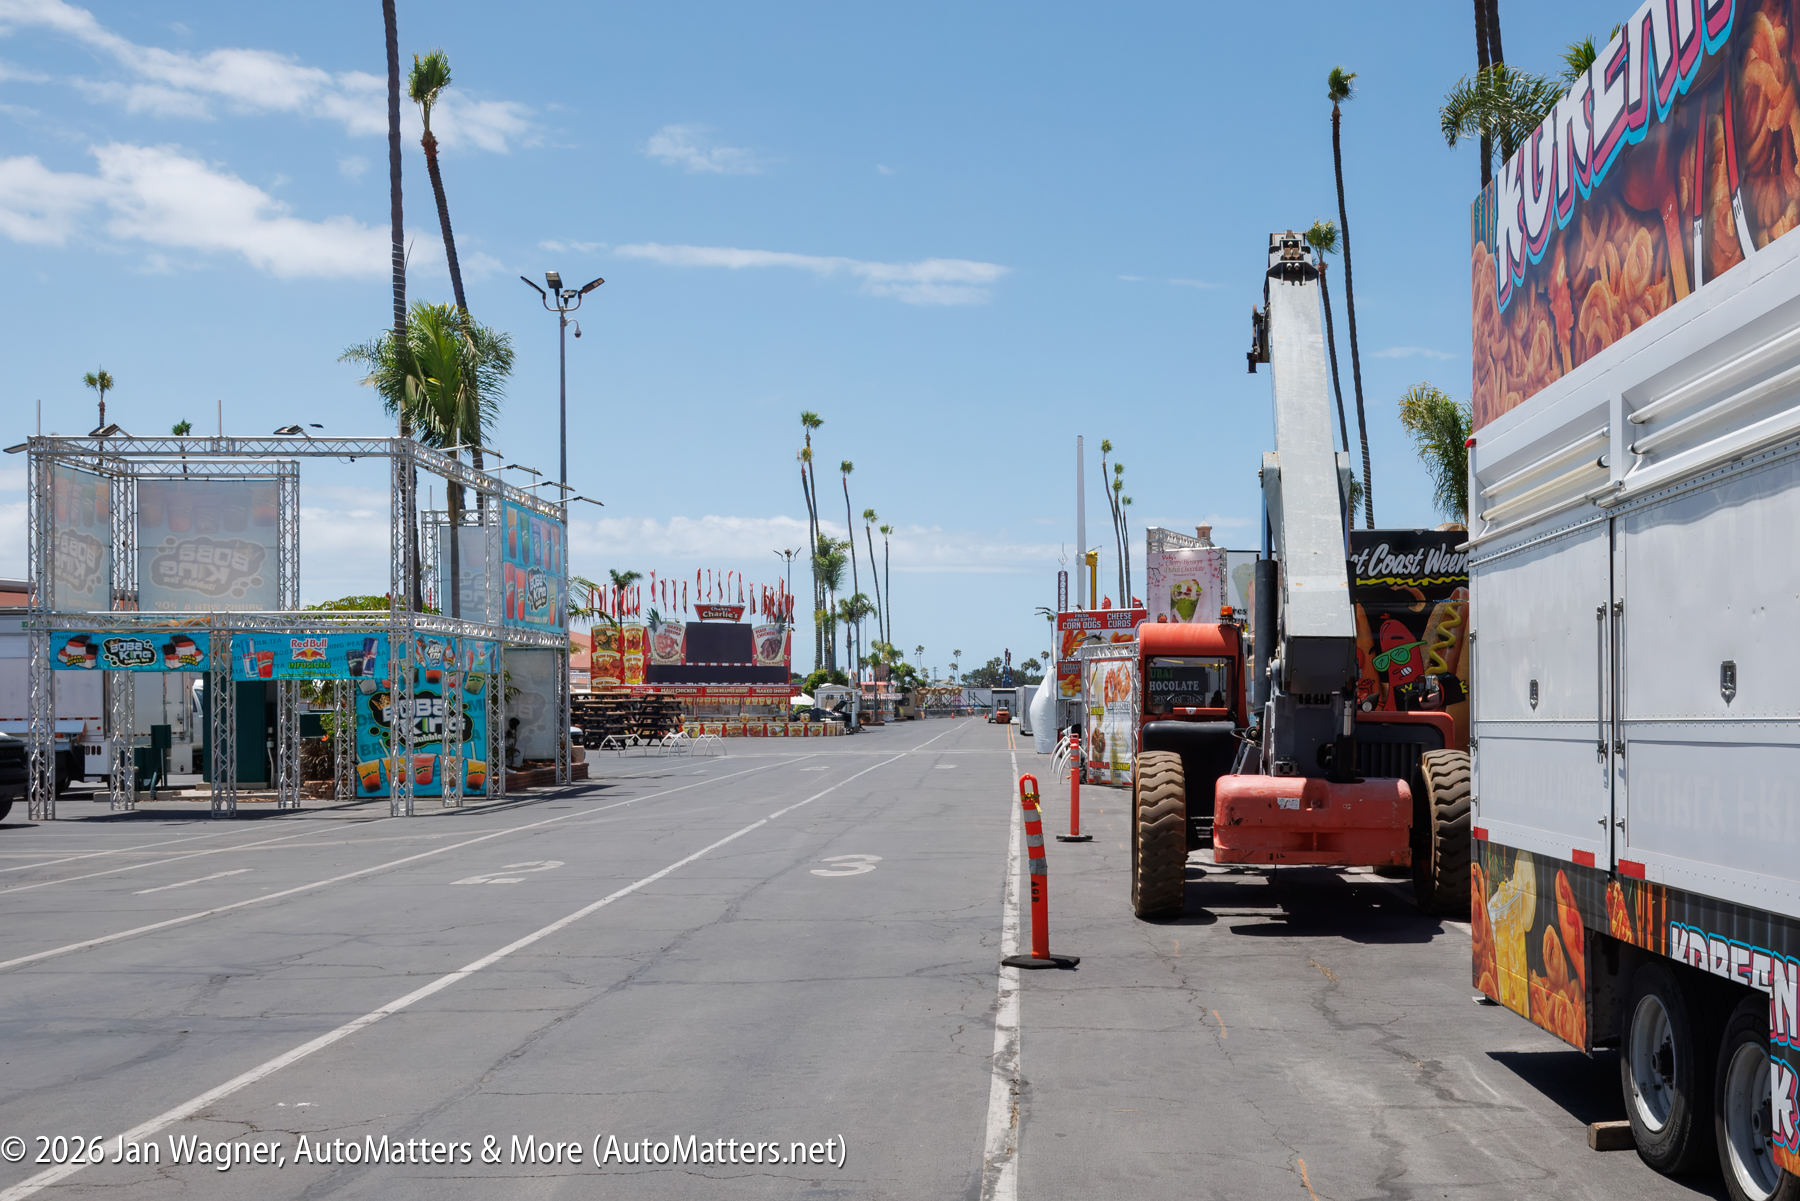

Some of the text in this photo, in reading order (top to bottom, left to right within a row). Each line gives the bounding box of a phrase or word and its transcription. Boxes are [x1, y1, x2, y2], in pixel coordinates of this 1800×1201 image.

[1368, 543, 1425, 577] Coast
[702, 611, 738, 619] Charlie's
[1106, 612, 1132, 620] CHEESE
[1082, 621, 1101, 629] DOGS
[1107, 620, 1131, 628] CURDS
[110, 641, 143, 653] BOBA
[290, 638, 328, 648] Red Bull
[119, 650, 152, 660] KING
[1149, 680, 1200, 691] HOCOLATE
[809, 854, 883, 877] 3
[449, 860, 566, 885] 2
